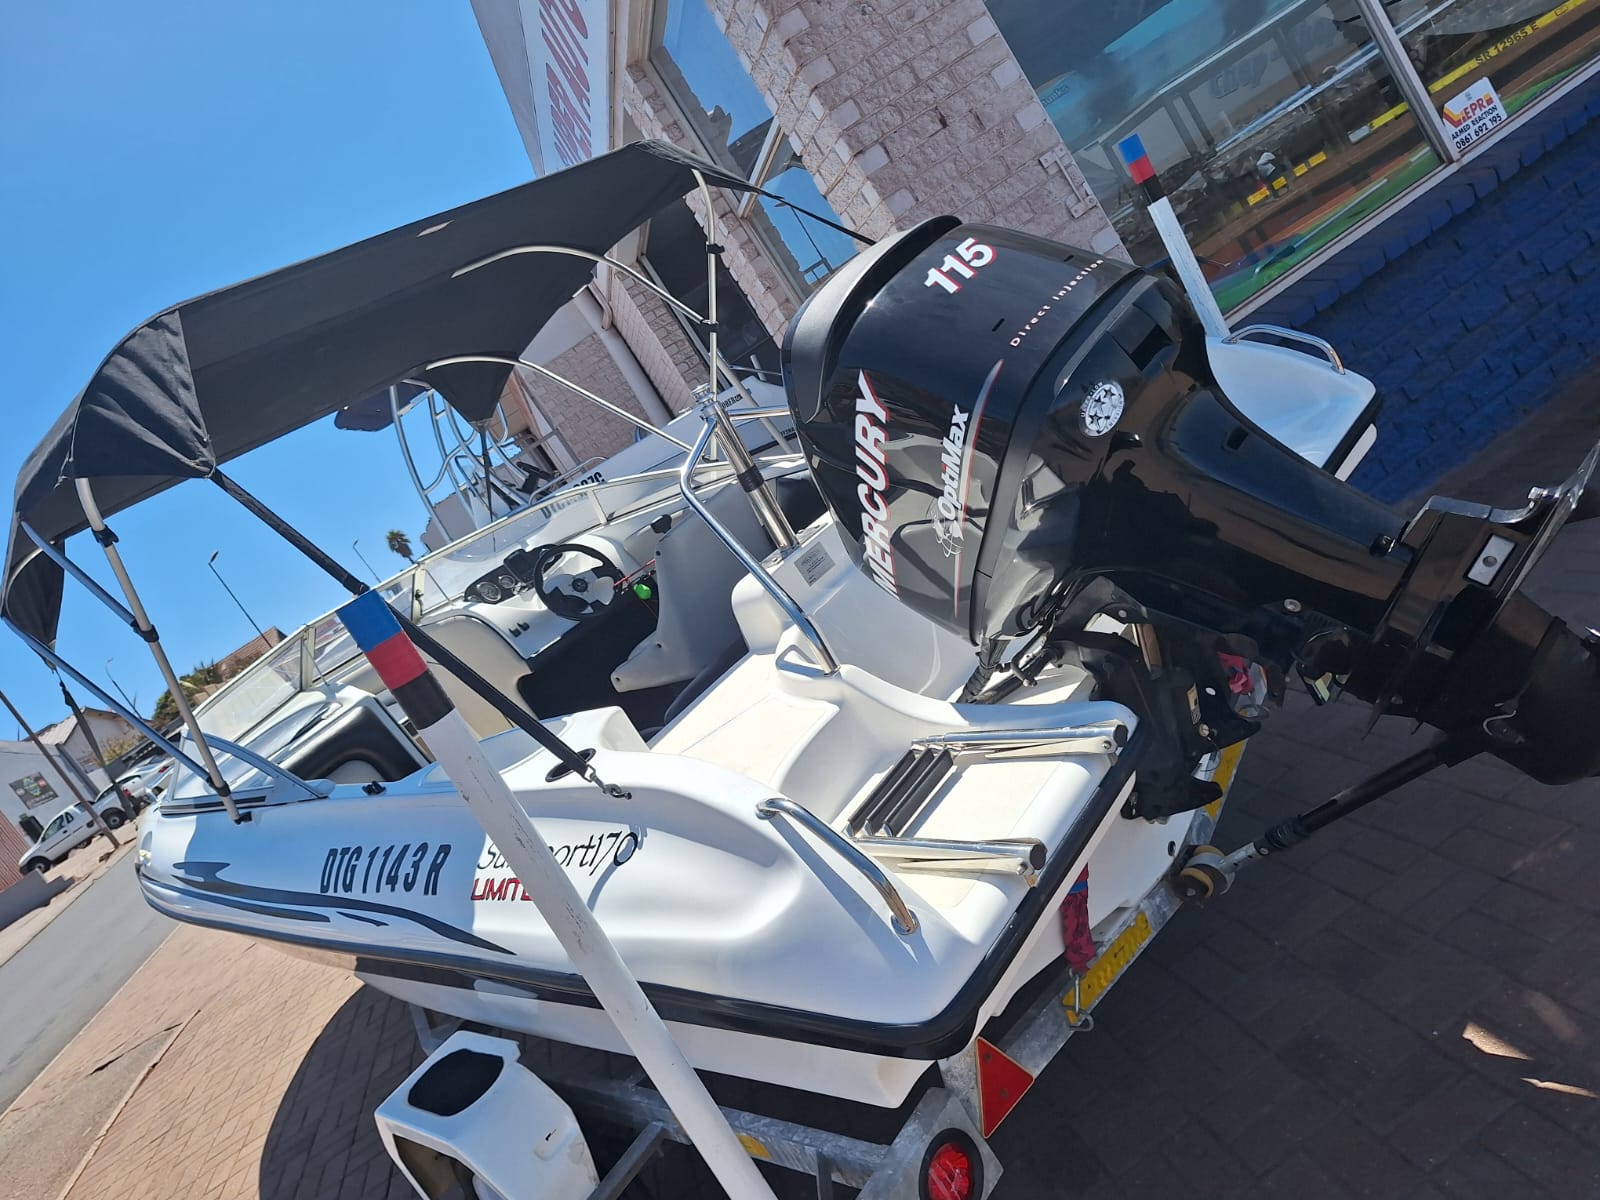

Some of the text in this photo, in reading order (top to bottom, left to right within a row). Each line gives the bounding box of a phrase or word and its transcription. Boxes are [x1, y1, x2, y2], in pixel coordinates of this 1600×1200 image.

[1451, 104, 1498, 140] ARMED REACTION
[1455, 112, 1502, 149] 0861 692 195
[924, 237, 998, 294] 115
[1009, 259, 1104, 347] Direct Injection
[855, 369, 900, 600] MERCURY
[937, 403, 969, 521] OptiMax
